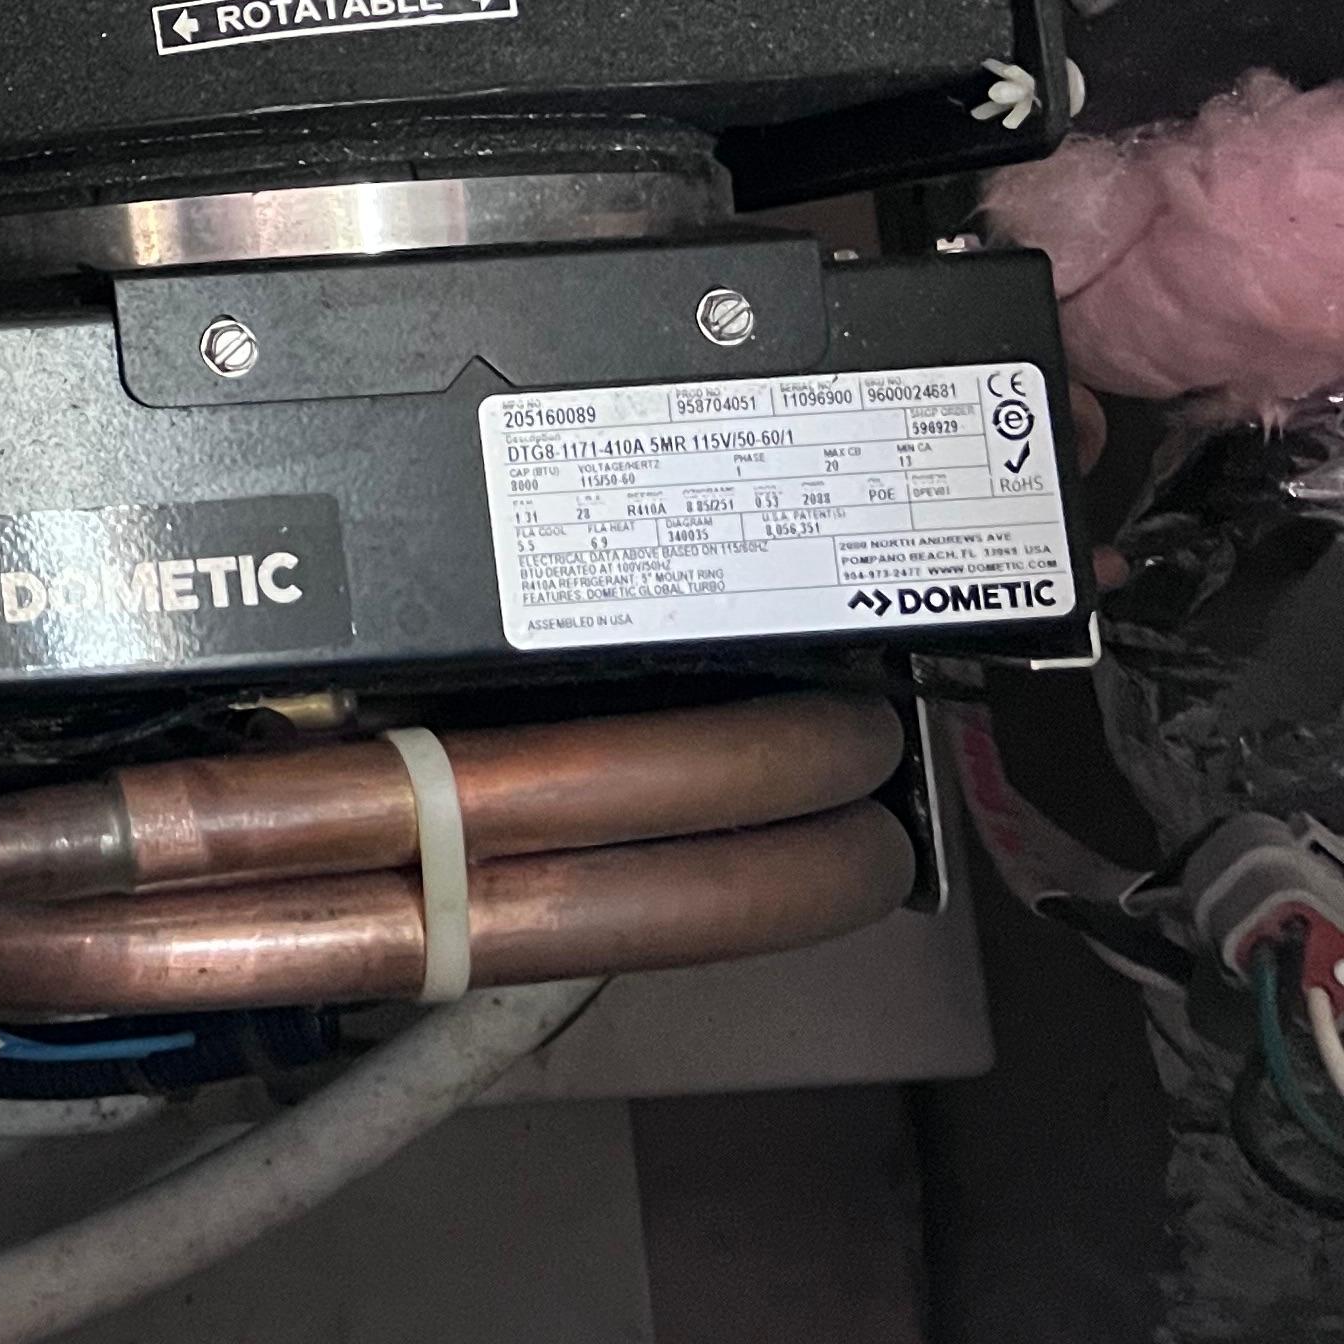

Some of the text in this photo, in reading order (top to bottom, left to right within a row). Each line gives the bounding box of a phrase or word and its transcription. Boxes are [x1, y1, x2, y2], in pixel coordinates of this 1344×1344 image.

[783, 389, 853, 409] 11096900
[867, 382, 957, 403] 9600024681
[677, 395, 757, 415] 958704051
[503, 406, 596, 429] 205160089
[507, 428, 794, 463] DTG8-1171-410A 5MR 115V/50-60/1
[823, 447, 845, 458] MAX
[917, 442, 933, 452] CA
[734, 453, 766, 464] PHASE
[509, 466, 561, 478] CAP (BTU)
[577, 459, 660, 474] VOLTAGE/HERTZ
[825, 460, 840, 473] 20
[755, 494, 779, 508] 053
[868, 487, 896, 502] POE
[626, 502, 668, 517] R410A
[686, 499, 734, 513] 885/251
[588, 520, 635, 534] FLA HEAT
[666, 516, 713, 529] DIAGRAM
[538, 525, 567, 537] COOL
[668, 528, 709, 542] 340035
[591, 536, 608, 549] 69
[870, 537, 915, 549] NORTH
[919, 534, 983, 547] ANDREWS
[986, 532, 1012, 543] AVE
[518, 551, 587, 568] ELECTRICAL
[590, 550, 621, 563] DATA
[623, 546, 659, 561] ABOVE
[663, 545, 699, 559] BASED
[702, 543, 718, 556] ON
[842, 553, 907, 566] POMPANO
[1024, 544, 1052, 555] USA
[520, 567, 543, 580] BTU
[546, 564, 597, 578] DERATED
[600, 562, 612, 574] AT
[522, 578, 557, 591] R410A
[655, 568, 693, 583] MOUNT
[697, 568, 724, 580] RING
[0, 552, 303, 624] DOMETIC
[587, 586, 637, 600] DOMETIC
[639, 582, 684, 596] GLOBAL
[688, 580, 726, 594] TURBO
[897, 578, 1057, 615] DOMETIC
[528, 613, 633, 632] ASSEMBLED IN USA
